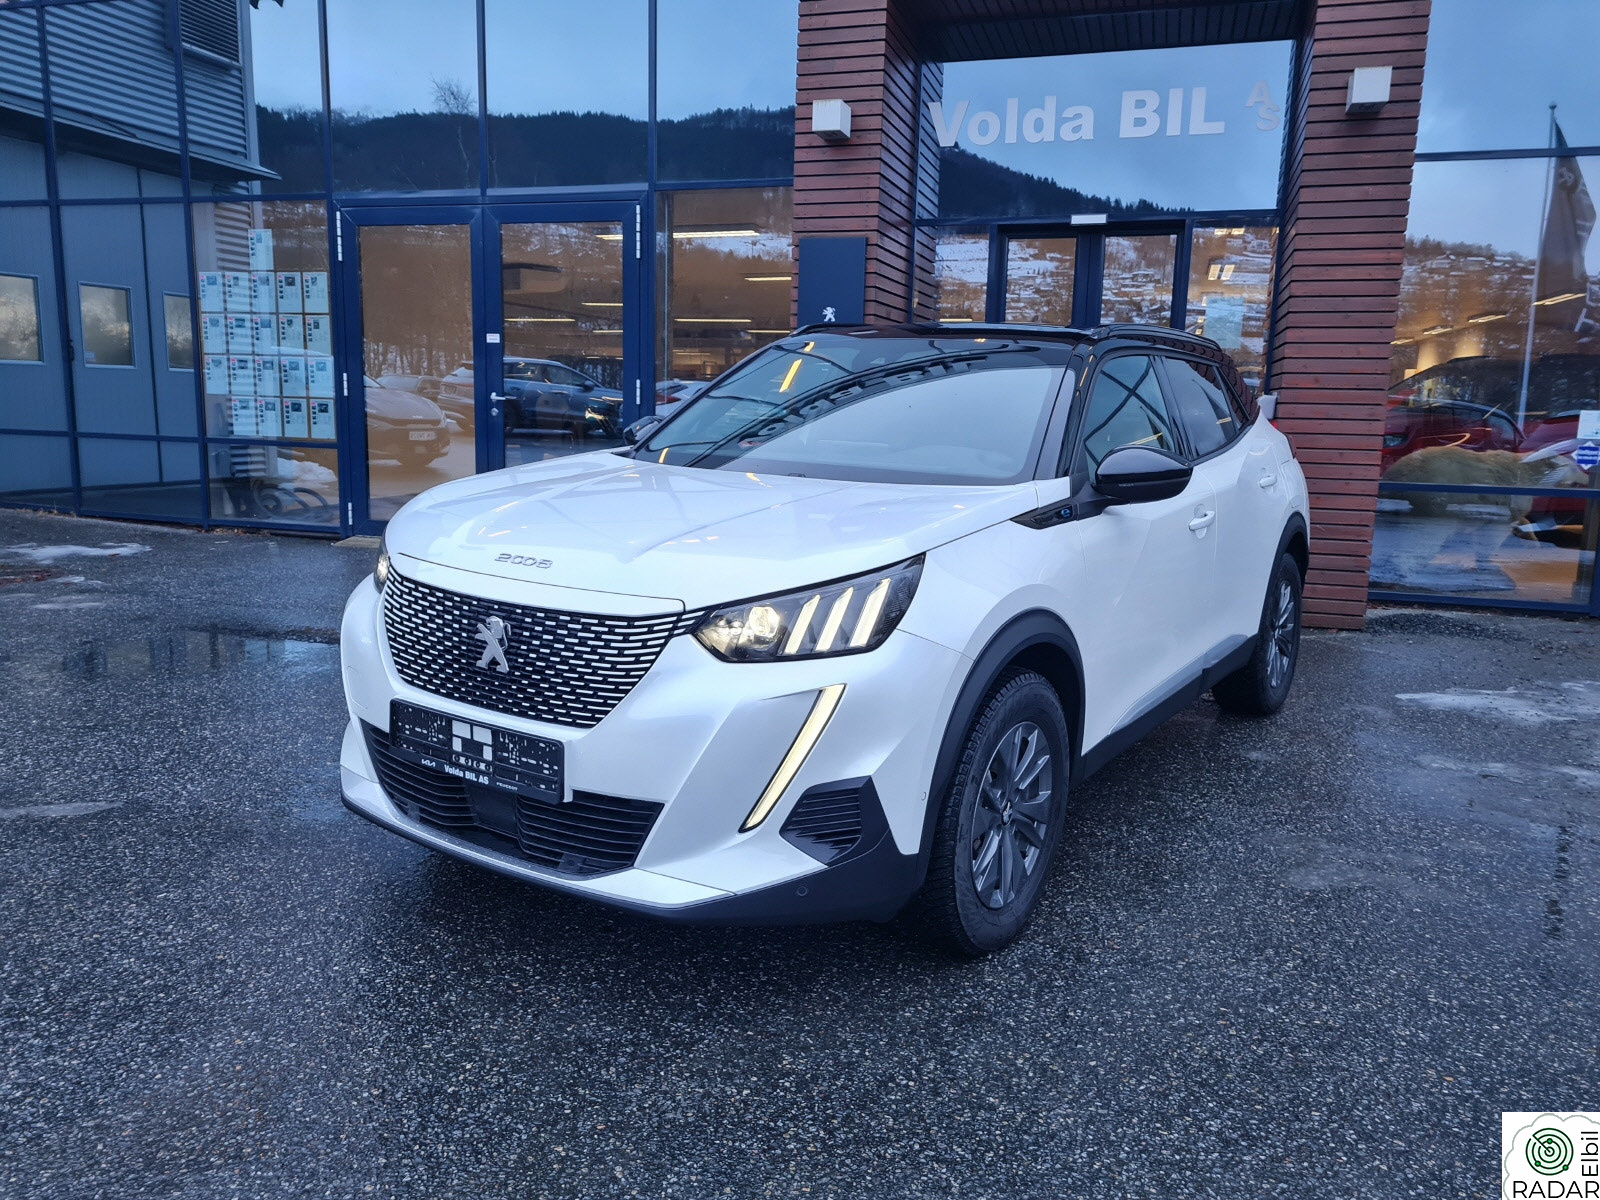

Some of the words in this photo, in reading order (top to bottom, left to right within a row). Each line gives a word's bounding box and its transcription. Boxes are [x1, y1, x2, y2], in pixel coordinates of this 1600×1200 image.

[928, 95, 1095, 147] Volda
[1118, 86, 1226, 139] BIL
[494, 552, 553, 569] 2008
[444, 764, 464, 778] Volda
[465, 770, 478, 782] BIL
[478, 775, 489, 785] AS
